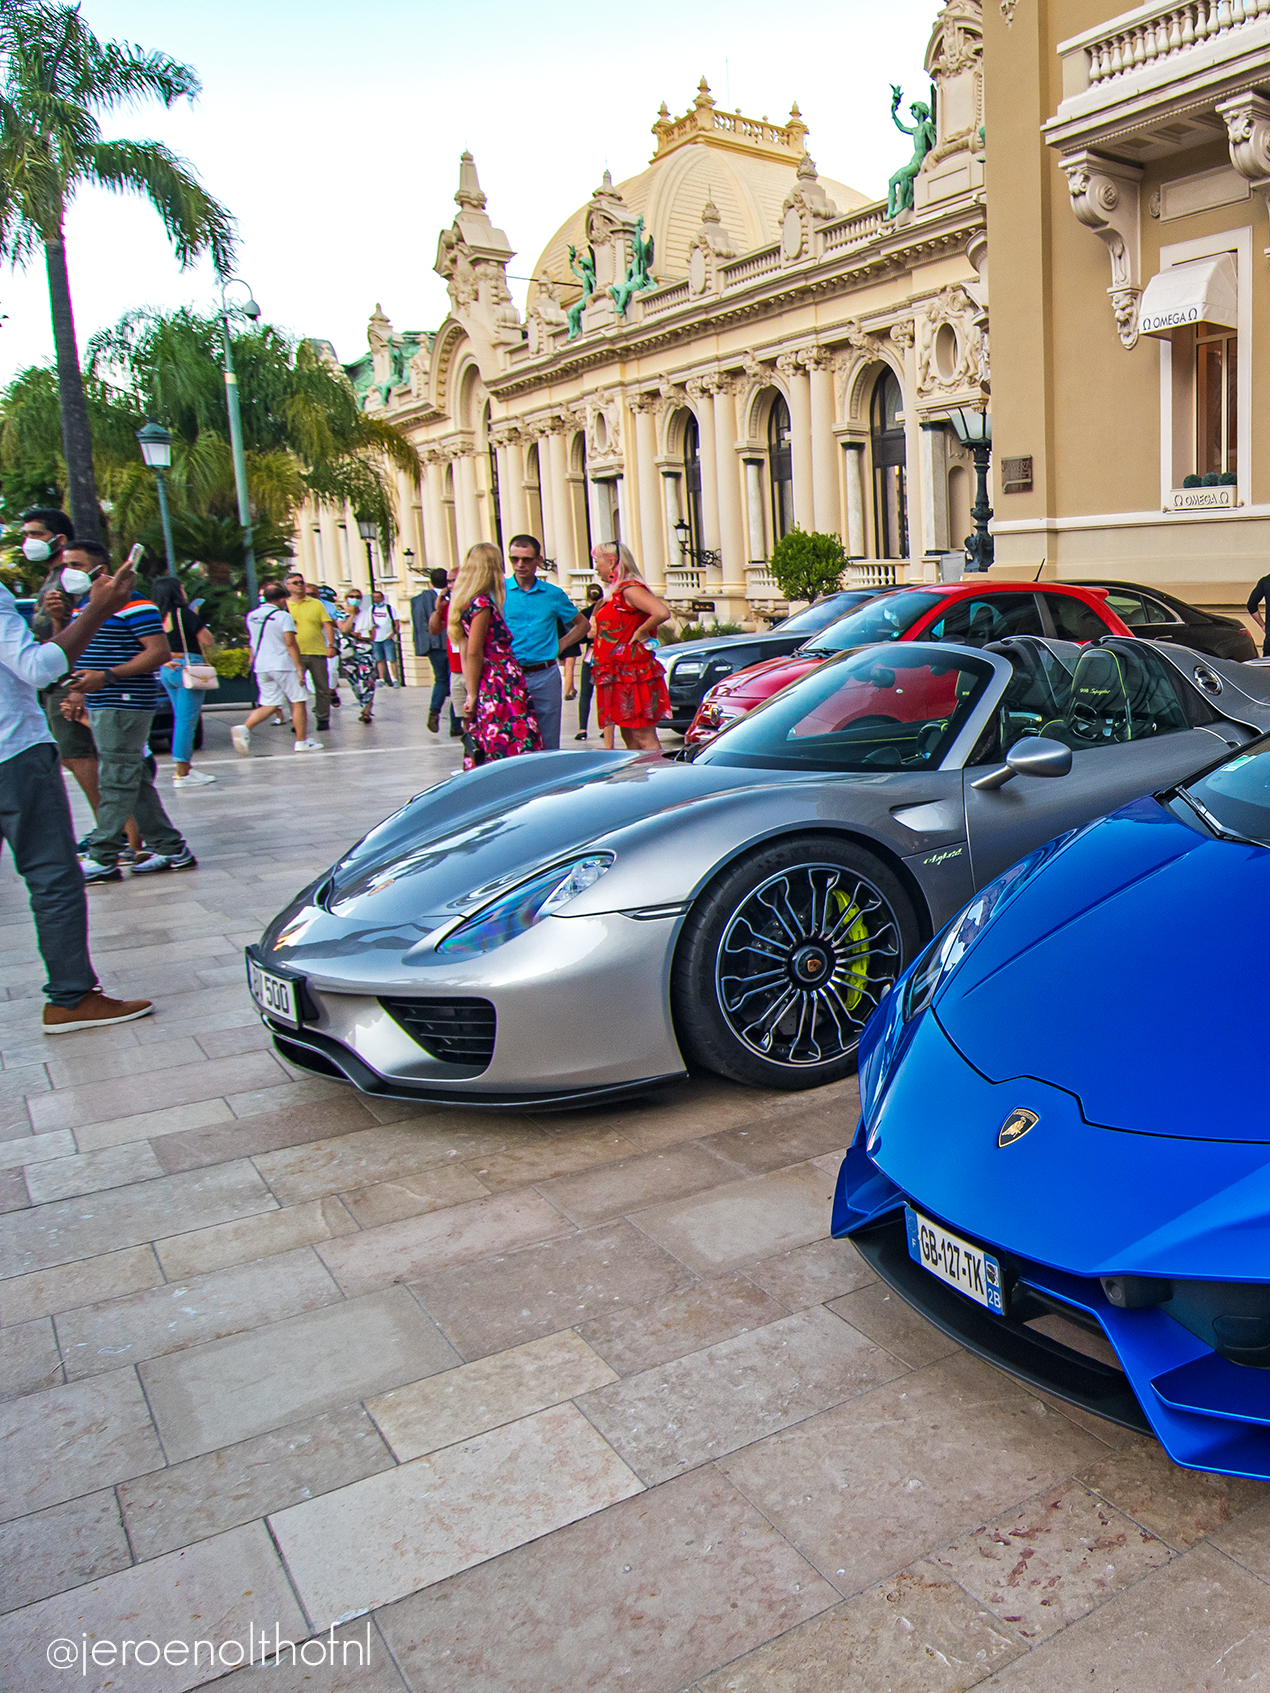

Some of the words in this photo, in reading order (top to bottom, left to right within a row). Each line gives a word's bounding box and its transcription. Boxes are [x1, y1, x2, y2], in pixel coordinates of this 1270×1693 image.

[1153, 311, 1187, 329] OMEGA
[1185, 493, 1218, 506] OMEGA
[264, 975, 290, 1014] 500
[920, 1225, 985, 1296] GB-127-TK
[987, 1288, 1001, 1309] 2B
